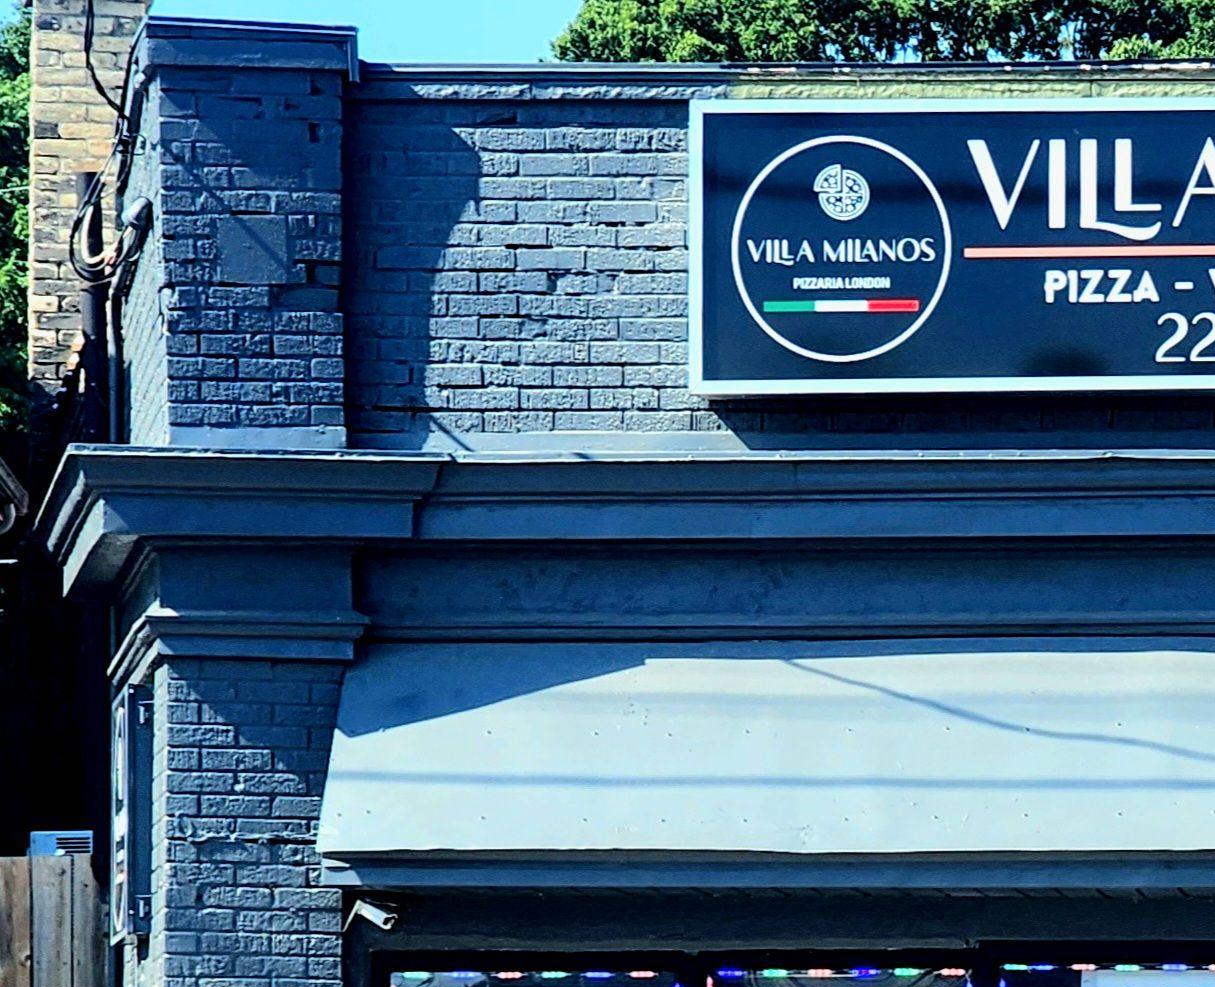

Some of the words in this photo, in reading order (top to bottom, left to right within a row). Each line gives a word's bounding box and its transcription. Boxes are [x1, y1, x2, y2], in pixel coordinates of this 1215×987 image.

[746, 238, 816, 267] VILLA
[822, 236, 937, 264] MILANOS
[792, 276, 844, 291] PIZZARIA
[845, 276, 891, 291] LONDON
[1043, 268, 1160, 304] PIZZA
